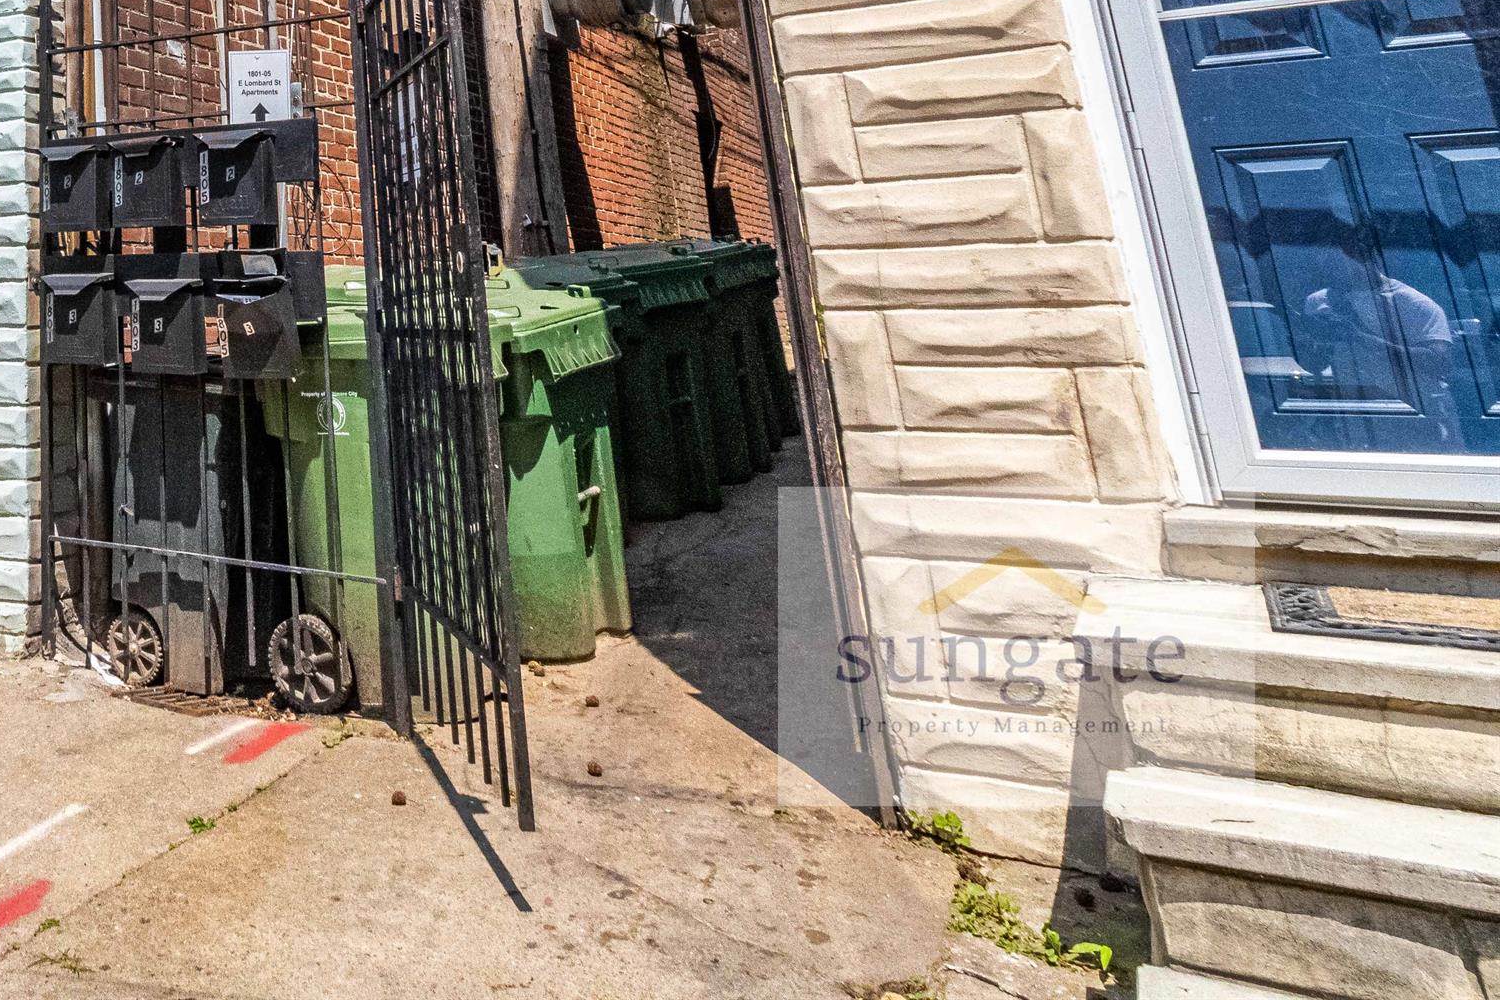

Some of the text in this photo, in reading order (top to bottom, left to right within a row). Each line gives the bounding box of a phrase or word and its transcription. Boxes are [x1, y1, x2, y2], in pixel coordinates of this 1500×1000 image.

[136, 172, 142, 184] 2
[227, 167, 234, 180] 2
[69, 311, 76, 323] 3
[155, 320, 162, 331] 3
[218, 305, 228, 355] 1805
